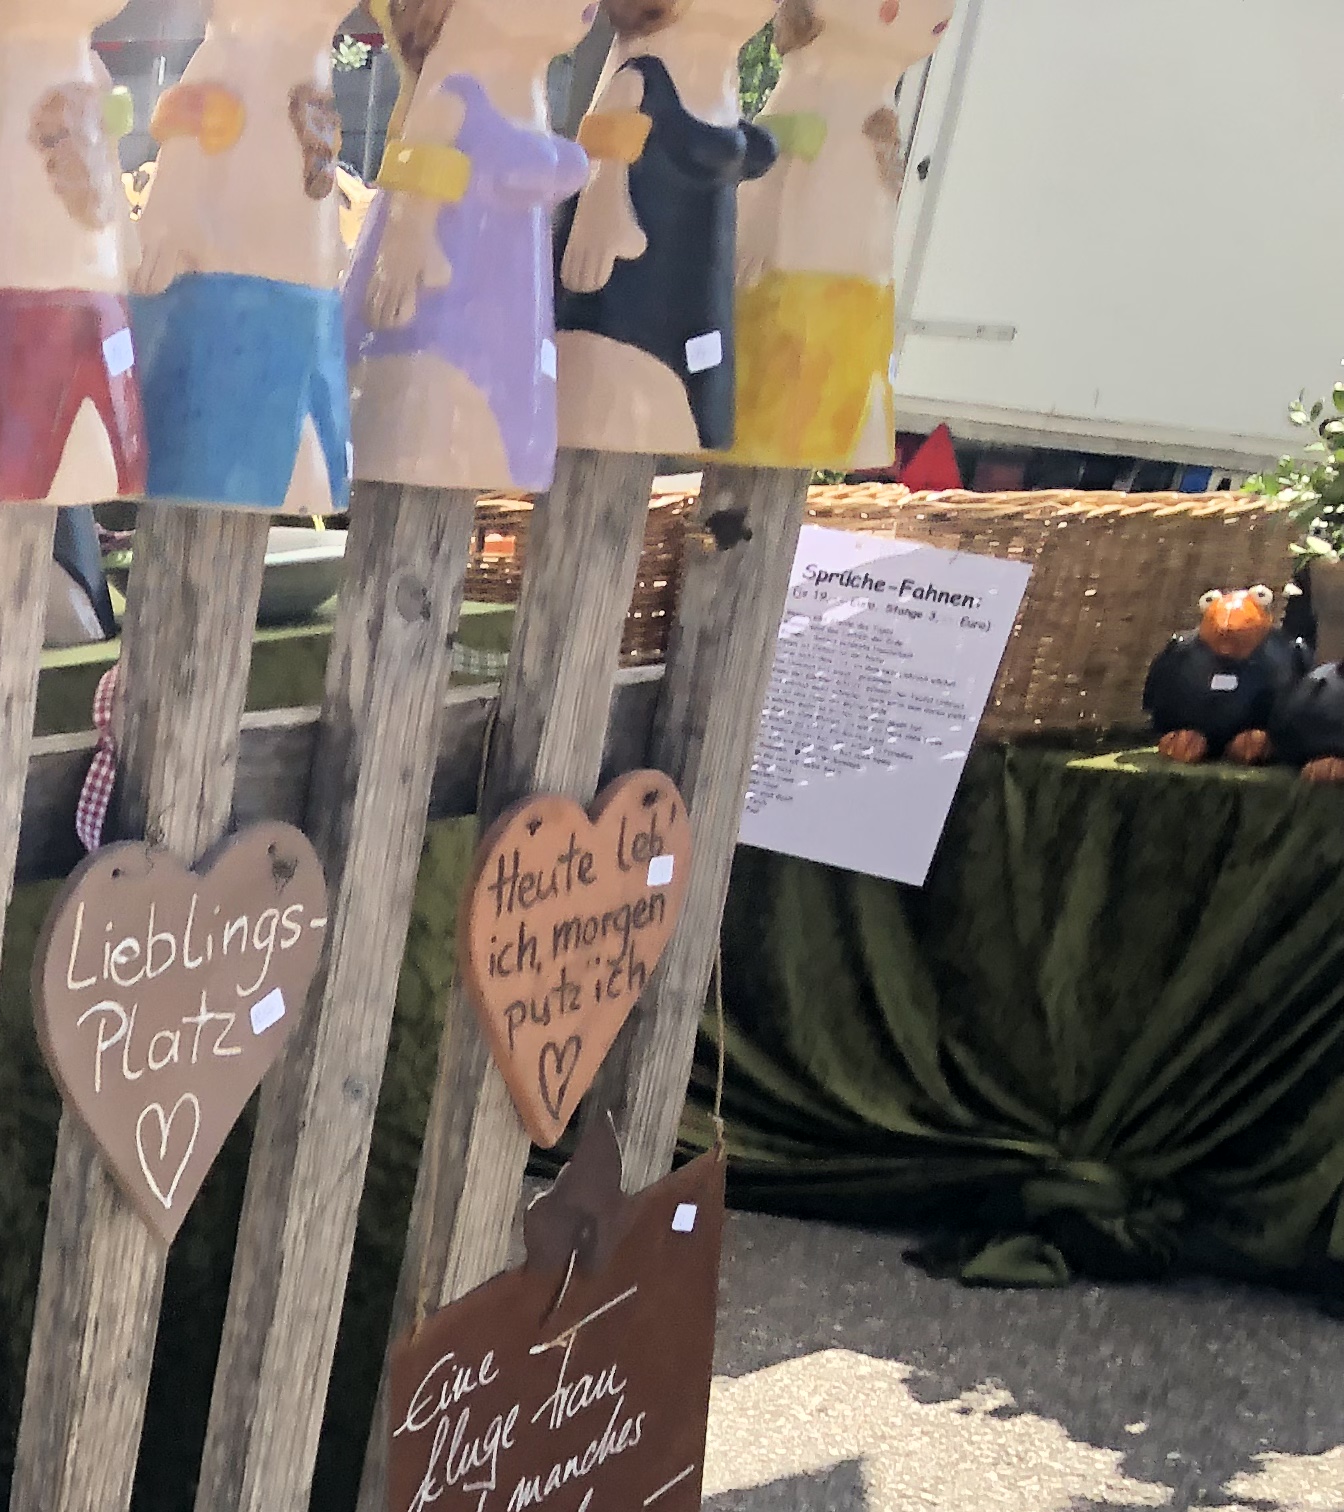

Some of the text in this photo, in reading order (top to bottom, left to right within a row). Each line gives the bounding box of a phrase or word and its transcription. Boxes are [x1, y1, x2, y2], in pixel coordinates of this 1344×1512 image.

[488, 832, 597, 918] Heute
[66, 893, 327, 998] Lieblings-
[488, 893, 665, 977] ich, morgen
[595, 941, 647, 1002] ich
[77, 990, 242, 1093] Platz
[393, 1350, 499, 1438] Eine
[529, 1286, 638, 1431] Frau
